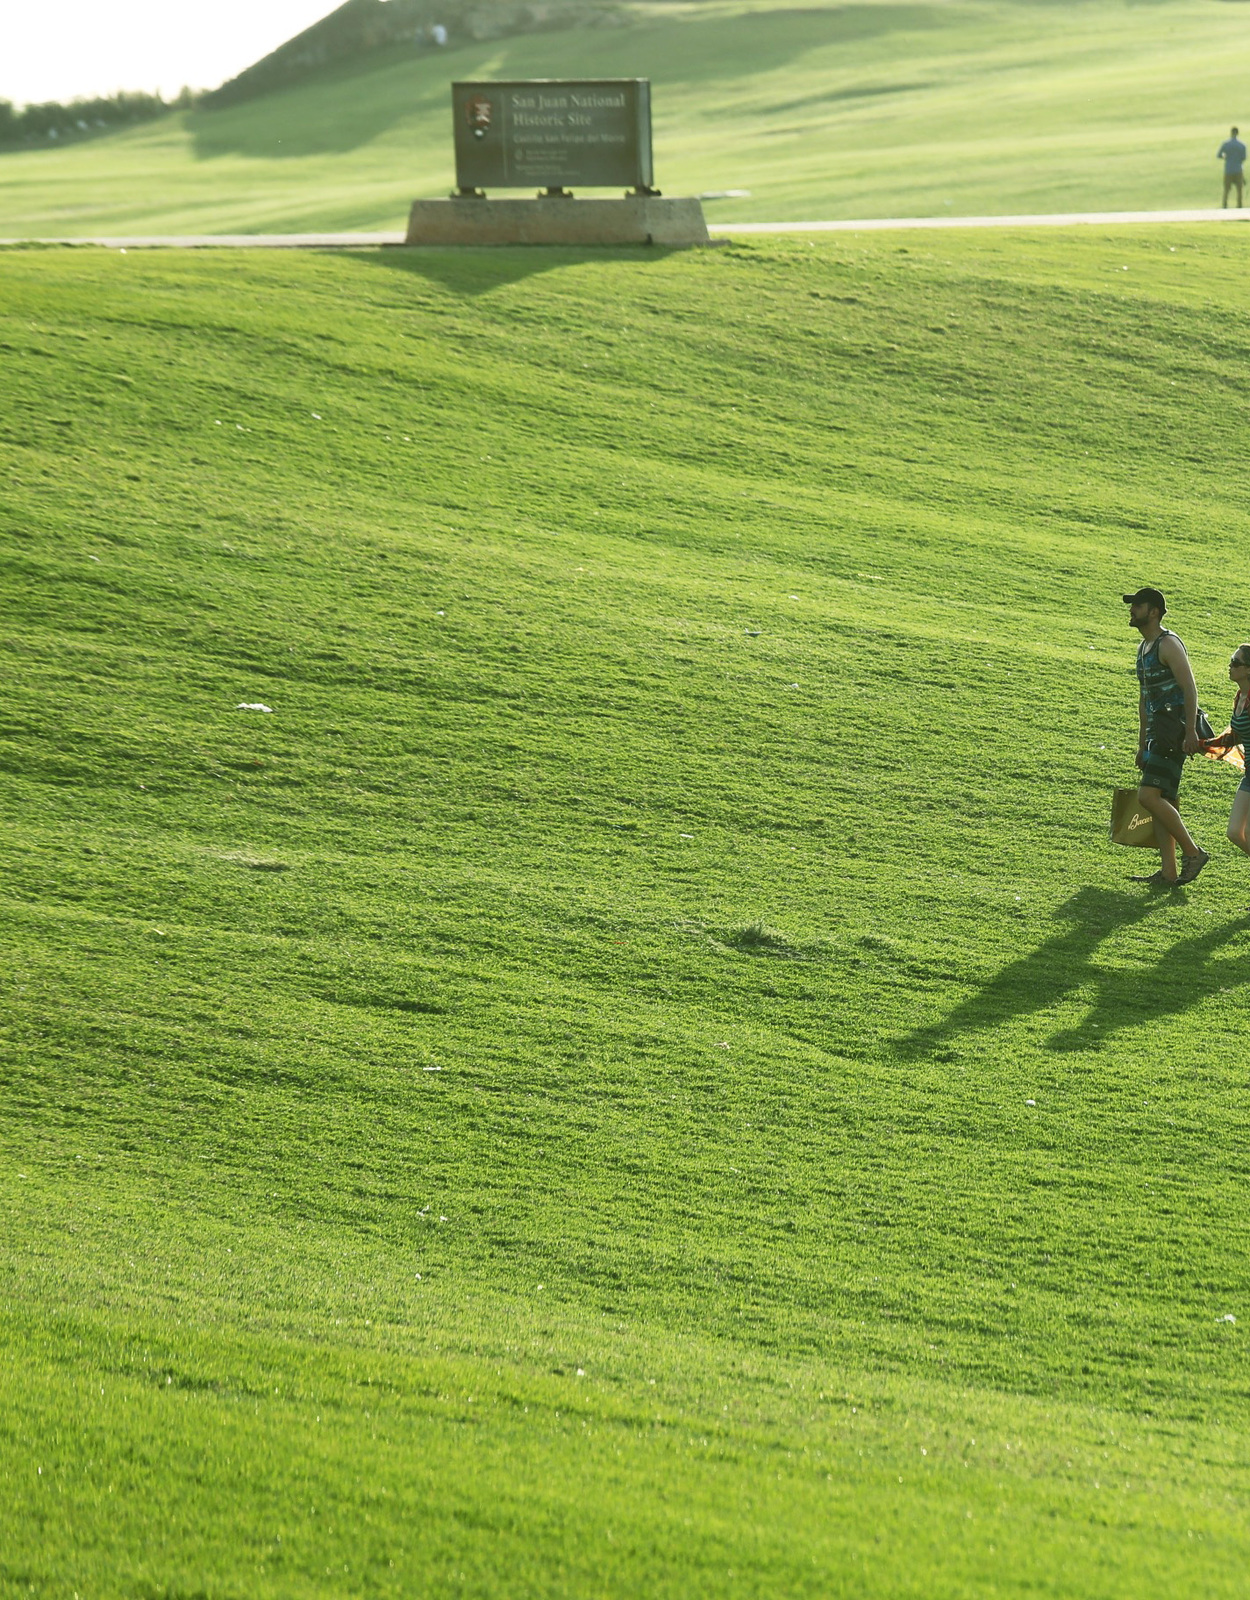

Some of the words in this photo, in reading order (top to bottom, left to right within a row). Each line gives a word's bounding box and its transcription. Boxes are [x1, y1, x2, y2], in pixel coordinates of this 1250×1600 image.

[512, 94, 536, 108] San
[538, 94, 567, 110] Juan
[570, 93, 626, 108] National
[513, 112, 564, 126] Historic
[567, 112, 592, 126] Site
